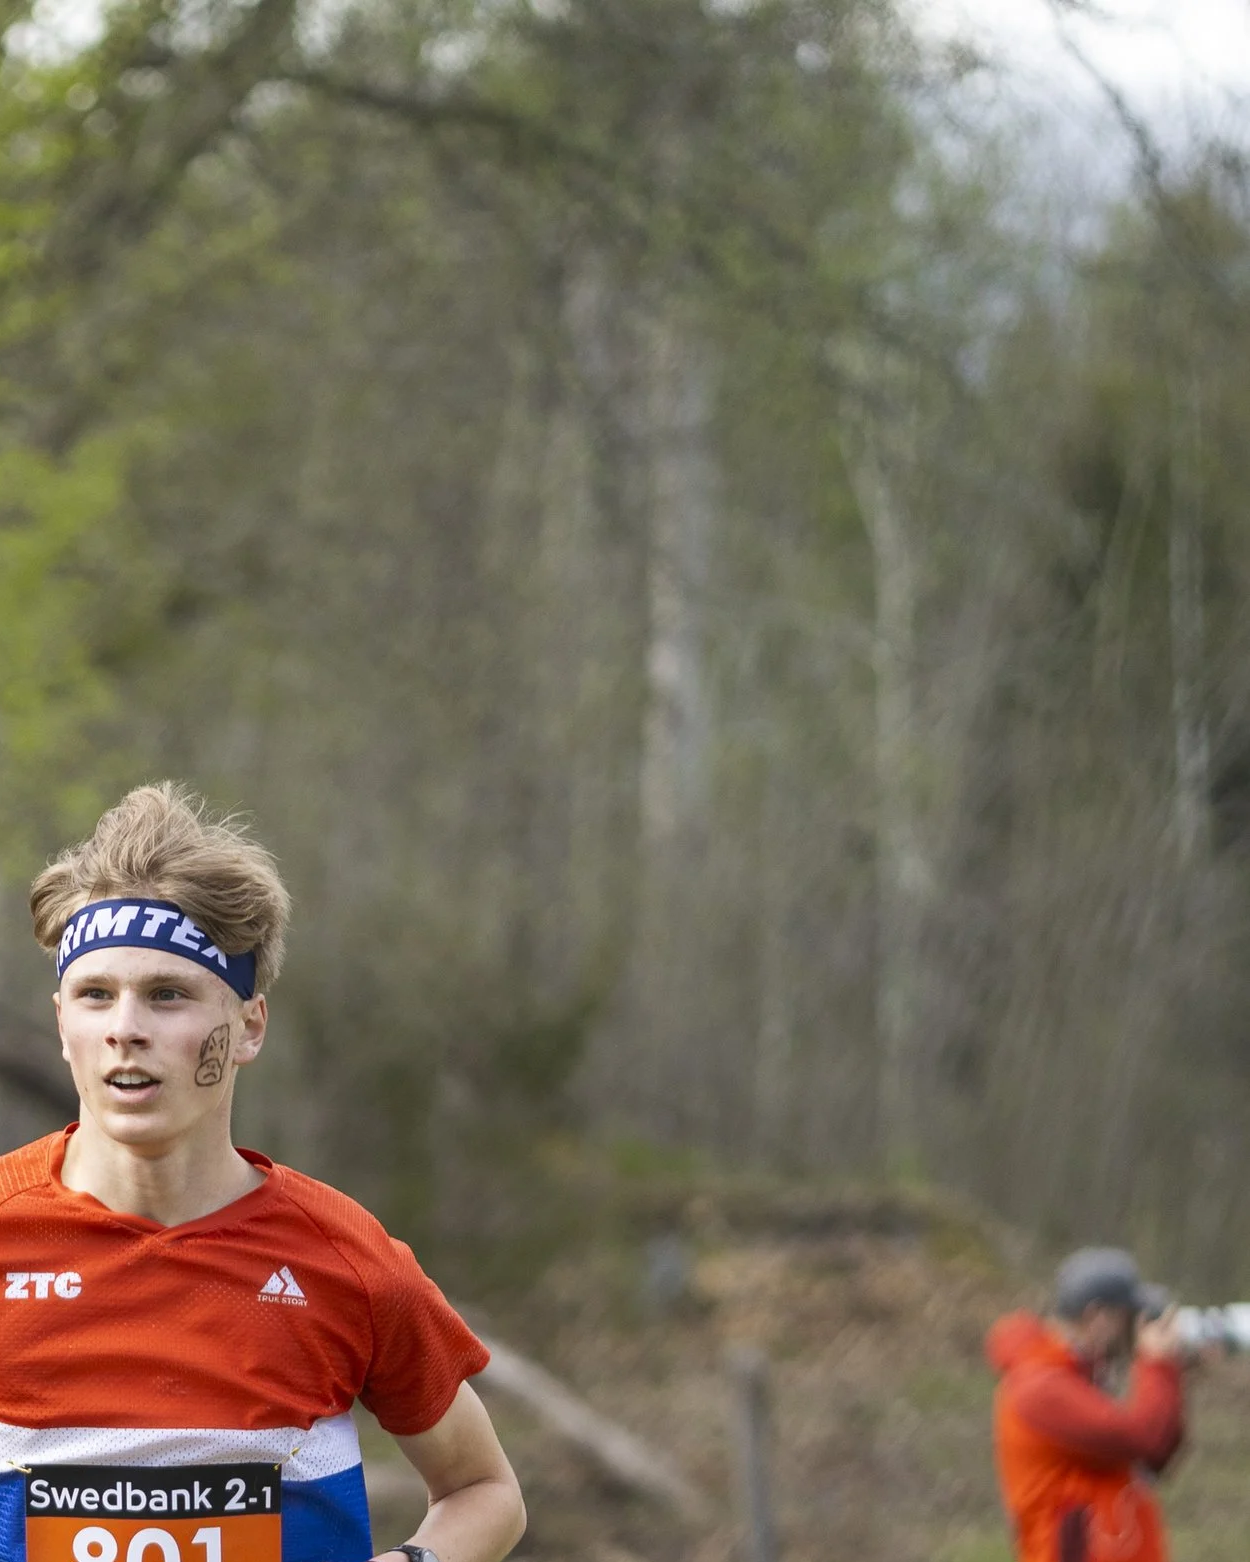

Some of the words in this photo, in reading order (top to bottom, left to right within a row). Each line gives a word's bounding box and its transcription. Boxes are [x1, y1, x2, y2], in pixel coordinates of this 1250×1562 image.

[56, 905, 228, 977] RIMTE
[4, 1271, 82, 1300] ZTC
[257, 1294, 280, 1303] TRUE
[282, 1297, 308, 1307] STORY
[29, 1479, 213, 1512] Swedbank
[224, 1478, 273, 1511] 2-1
